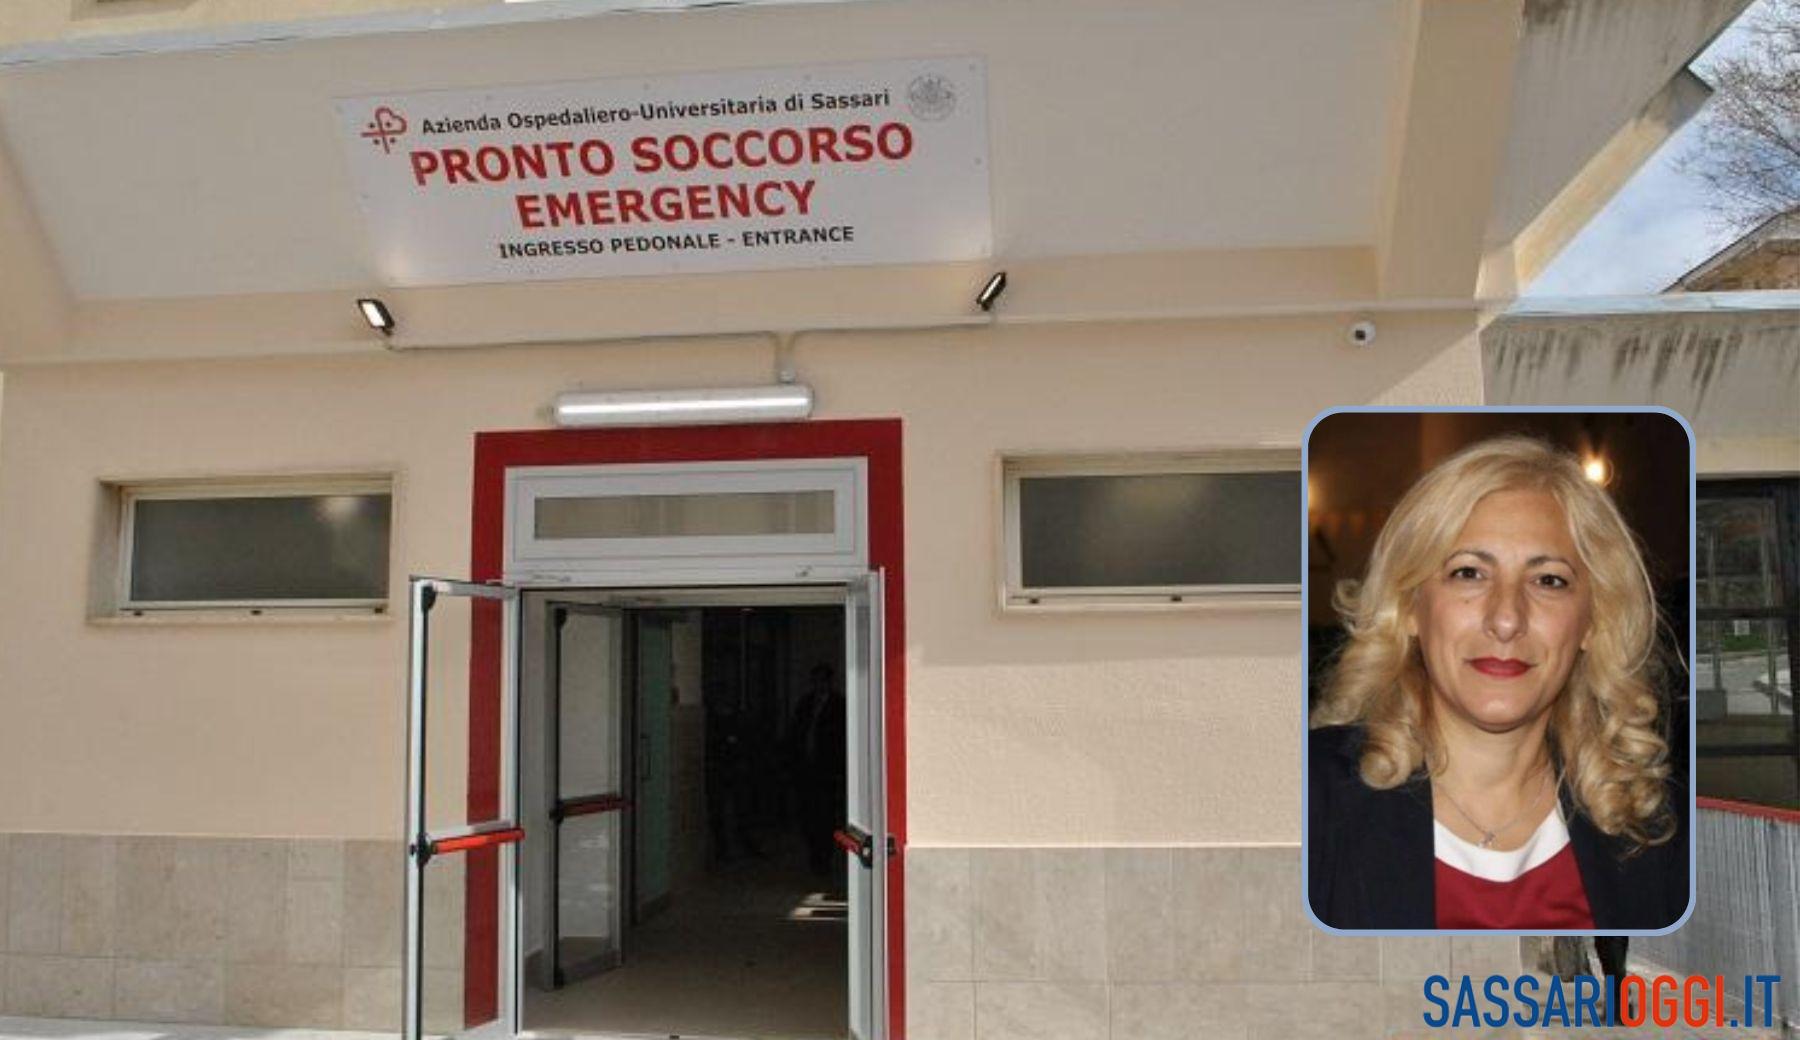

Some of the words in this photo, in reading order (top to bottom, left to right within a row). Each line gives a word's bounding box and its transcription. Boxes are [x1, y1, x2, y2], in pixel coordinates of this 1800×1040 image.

[422, 114, 502, 135] Azienda
[508, 96, 777, 131] Ospedaliero-Universitaria
[784, 93, 804, 112] di
[811, 88, 890, 111] Sassari
[409, 139, 614, 186] PRONTO
[632, 122, 914, 174] SOCCORSO
[516, 180, 816, 229] EMERGENCY
[499, 237, 605, 259] INGRESSO
[610, 232, 721, 253] PEDONALE
[742, 226, 854, 247] ENTRANCE
